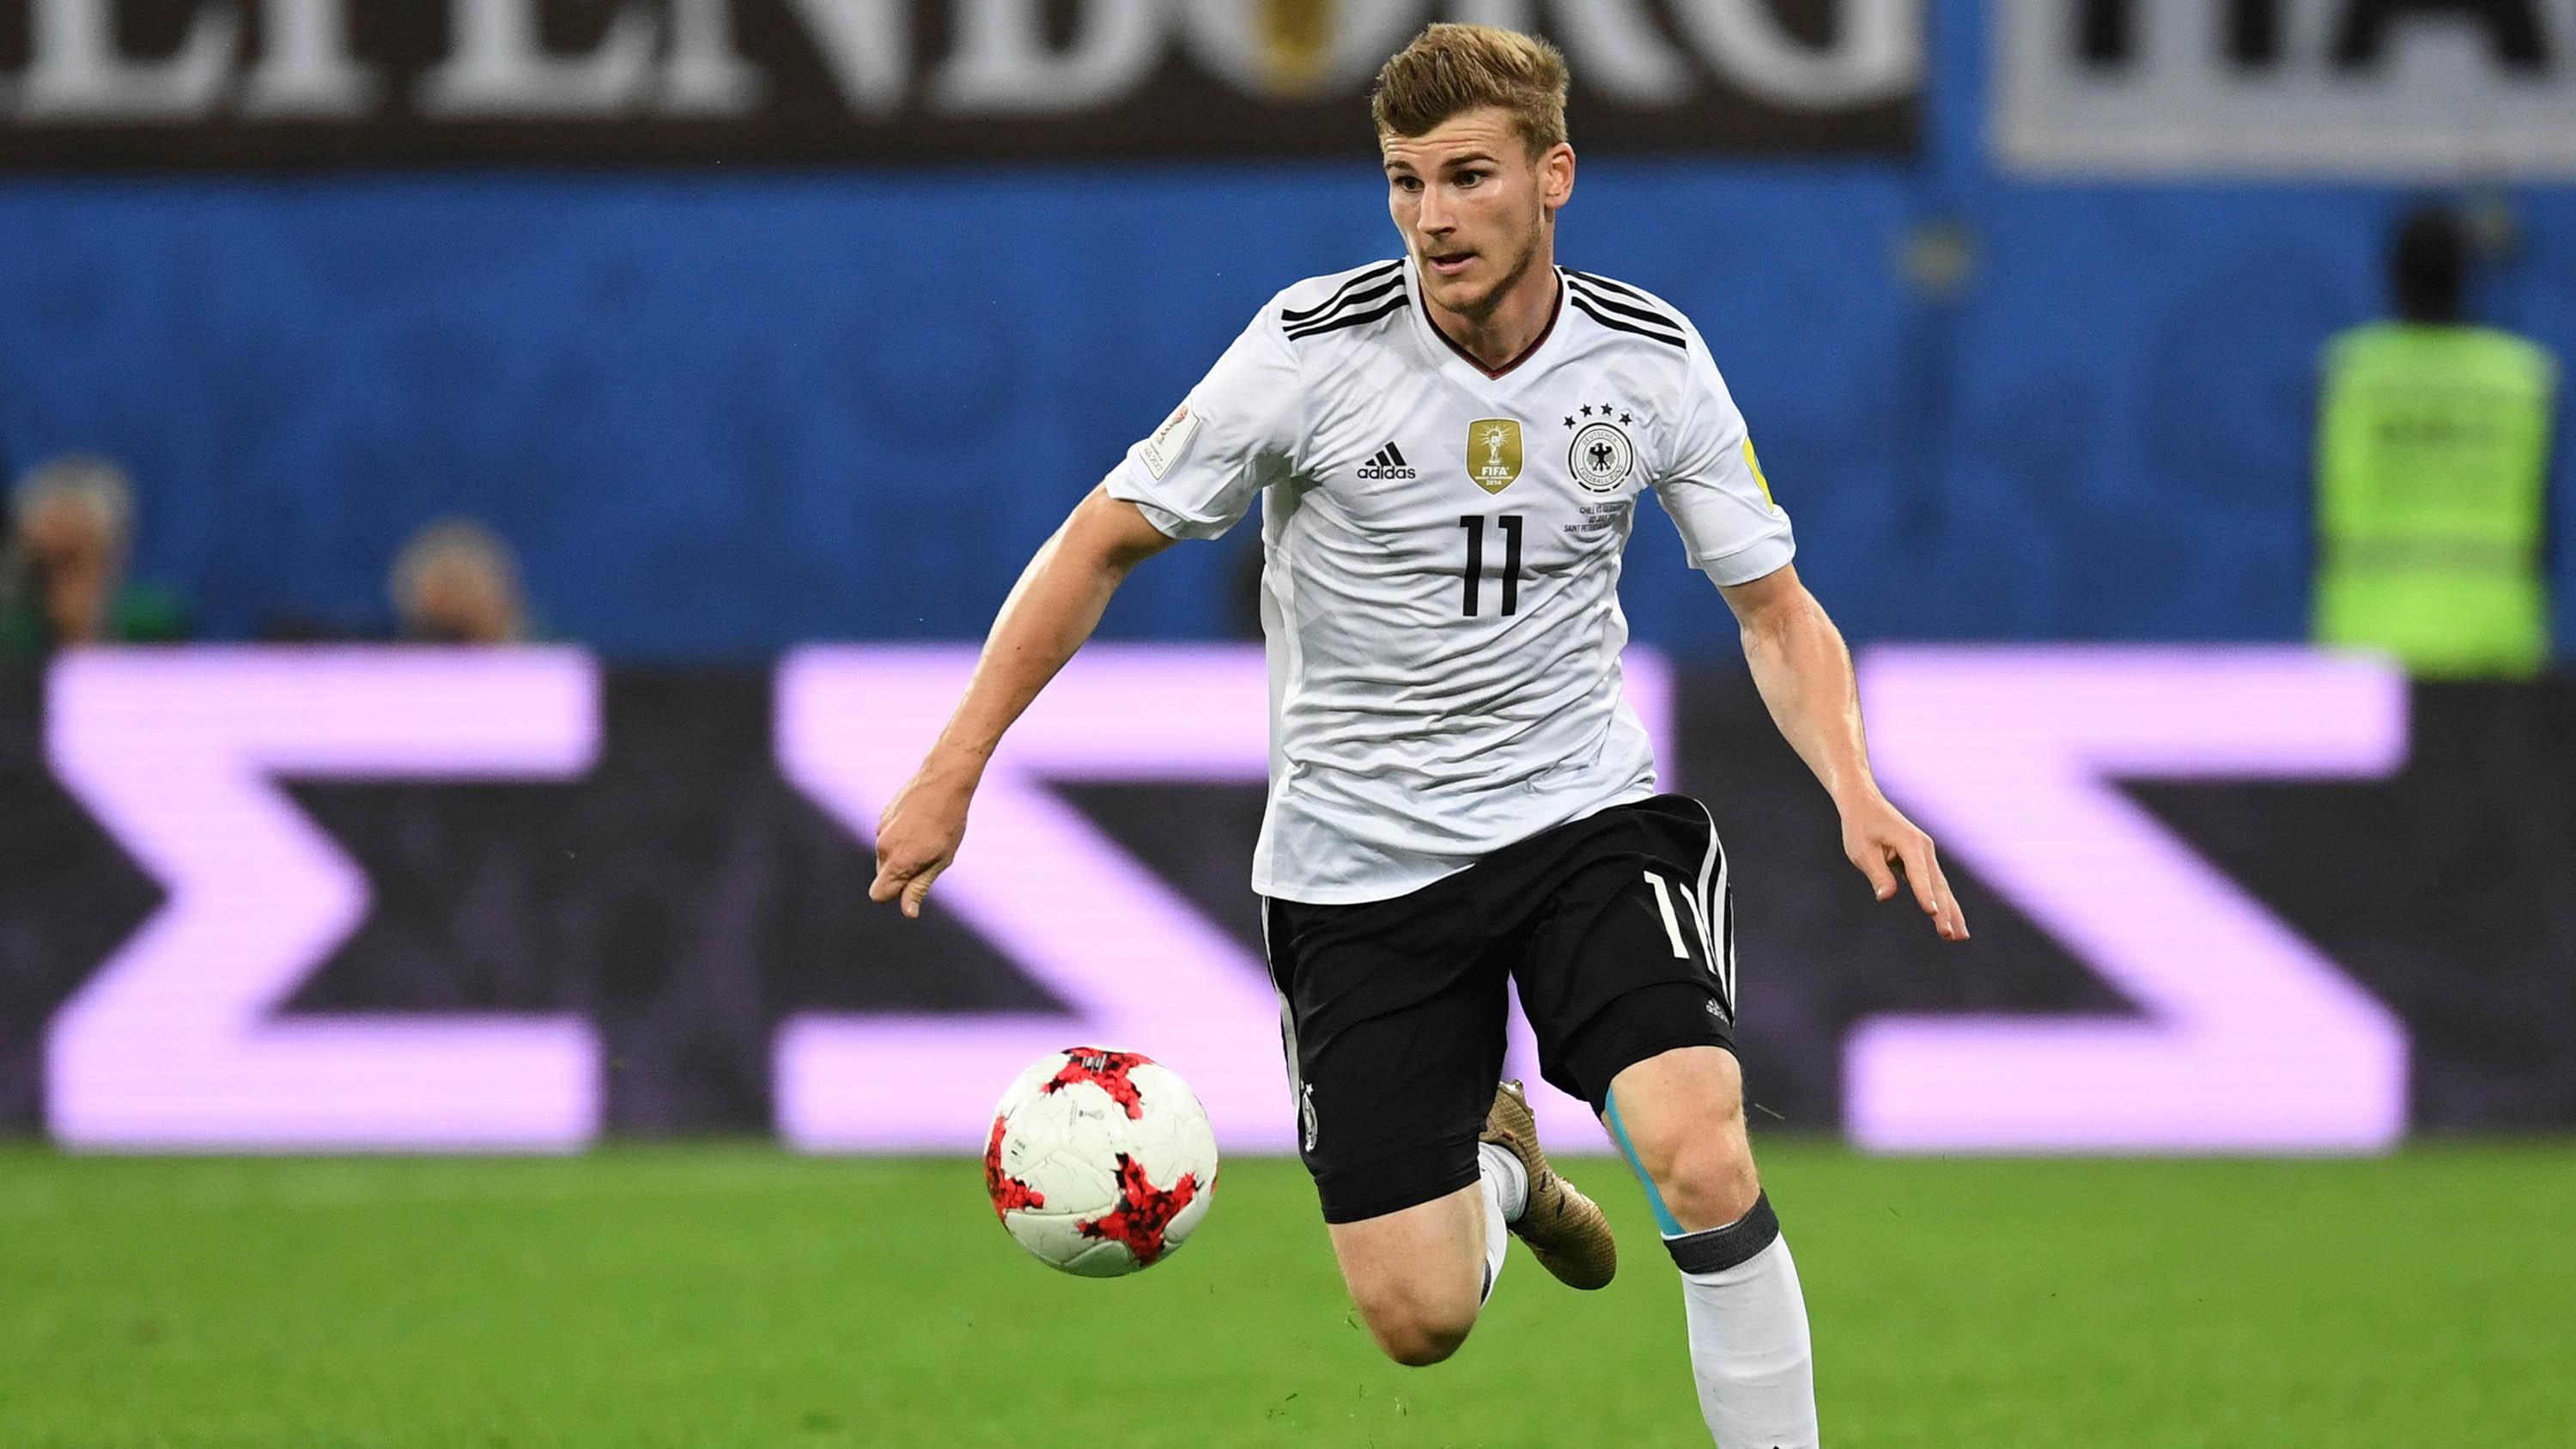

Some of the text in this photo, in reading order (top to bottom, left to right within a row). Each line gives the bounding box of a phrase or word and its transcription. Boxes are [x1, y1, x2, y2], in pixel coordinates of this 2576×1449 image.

[1358, 466, 1416, 479] adidas
[1481, 466, 1508, 476] FIFA
[1460, 514, 1523, 617] 11
